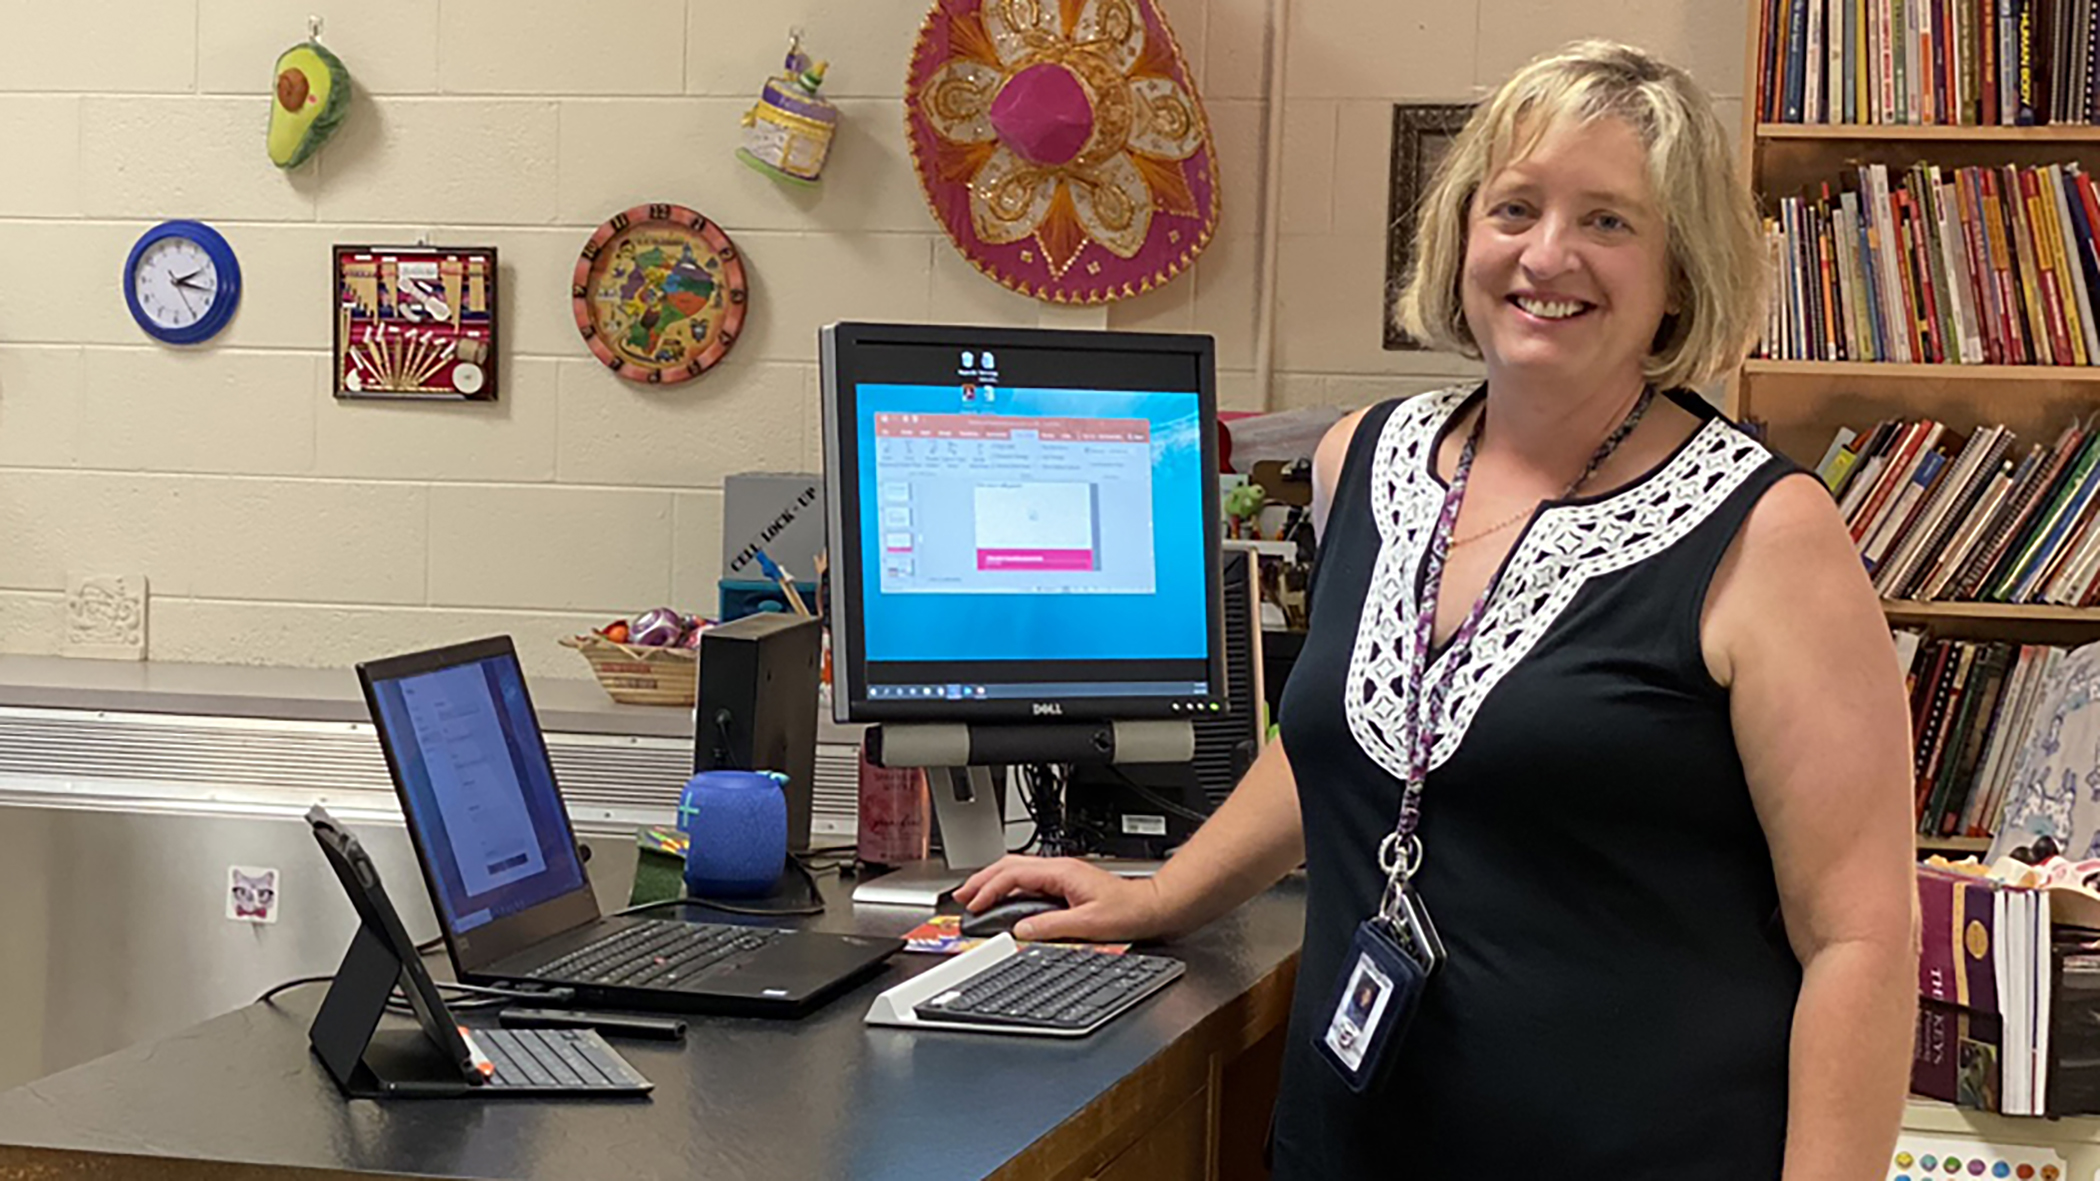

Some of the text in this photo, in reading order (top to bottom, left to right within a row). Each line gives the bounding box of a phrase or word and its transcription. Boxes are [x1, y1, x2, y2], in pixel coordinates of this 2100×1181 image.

[2020, 12, 2030, 66] HUMAN
[2020, 67, 2031, 106] BODY
[731, 487, 815, 572] CELL LOCK-UP
[1033, 703, 1062, 715] DELL
